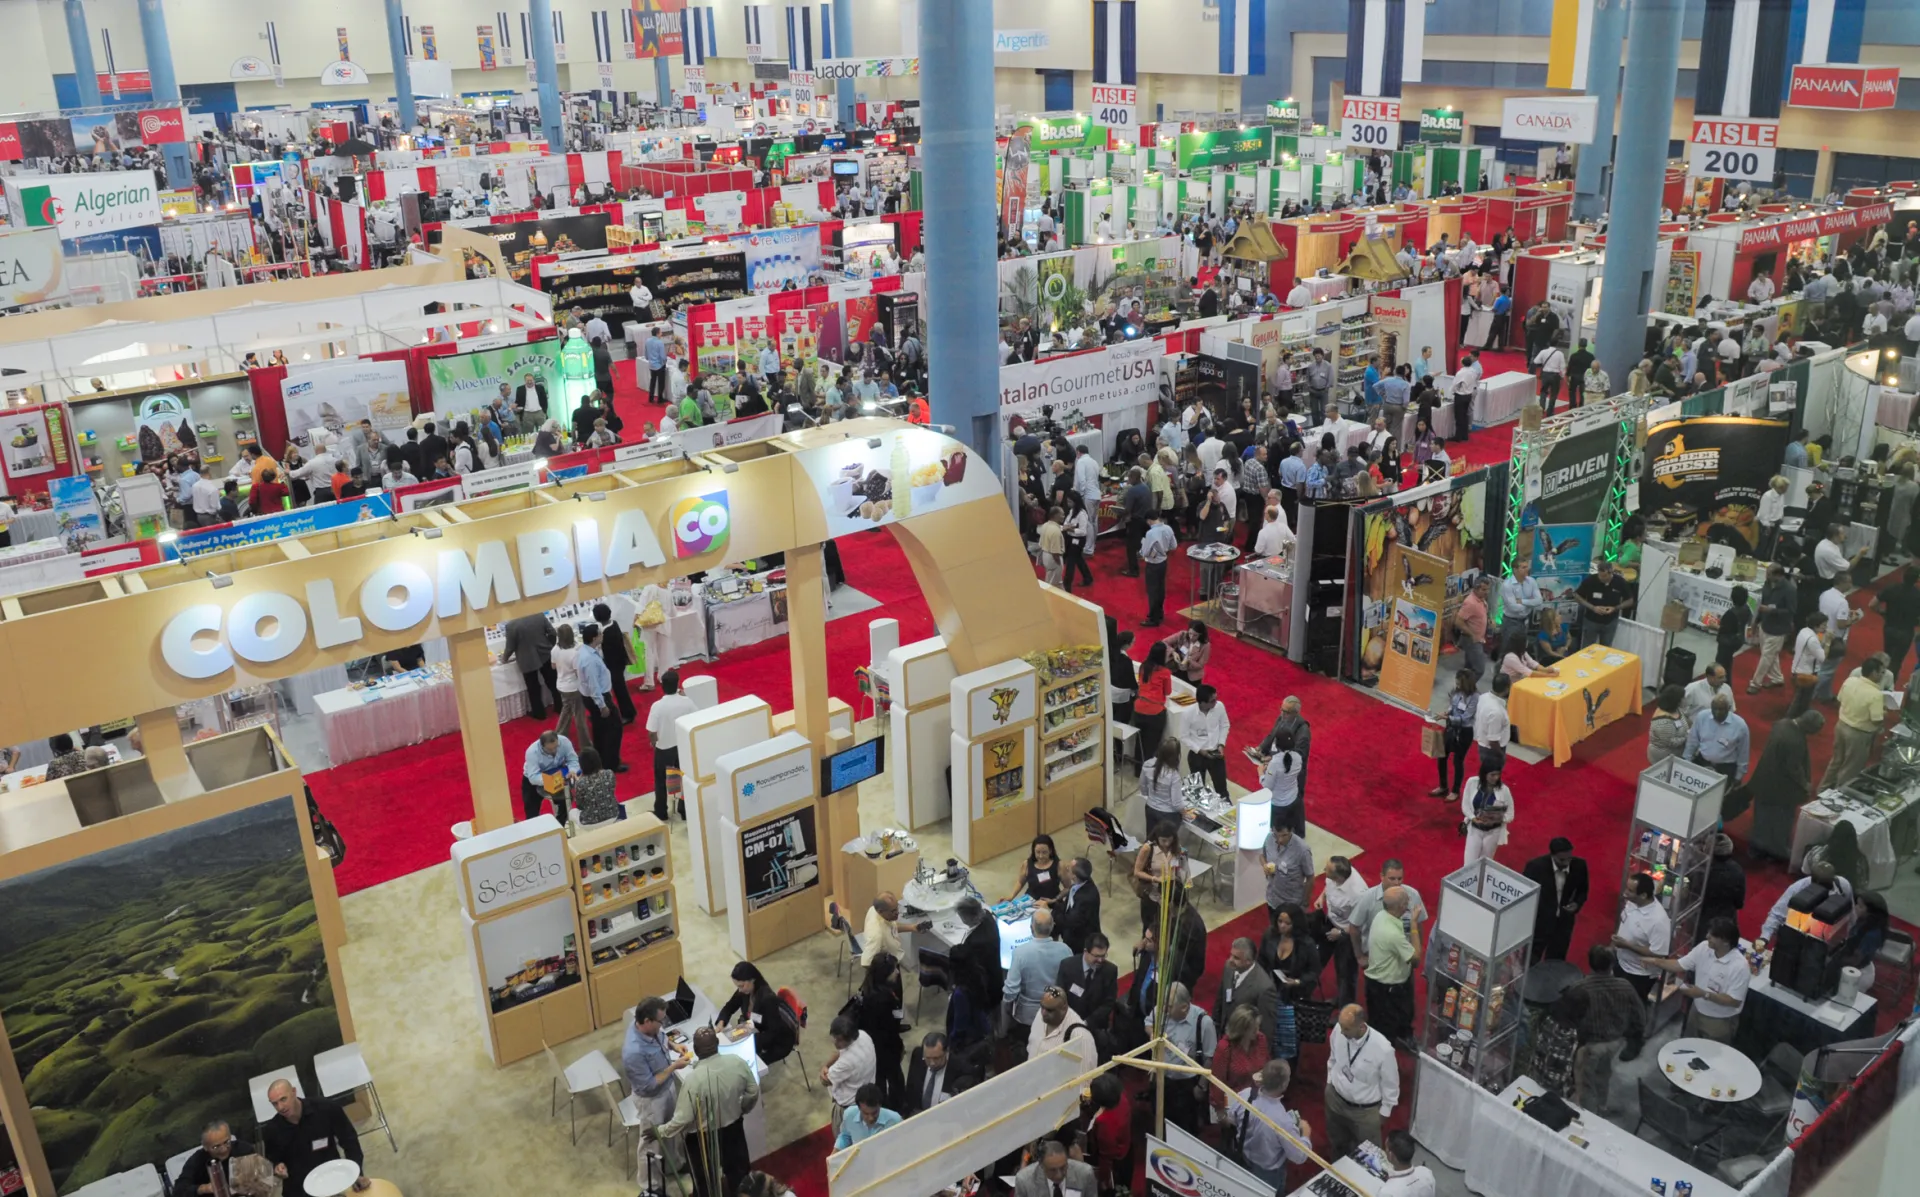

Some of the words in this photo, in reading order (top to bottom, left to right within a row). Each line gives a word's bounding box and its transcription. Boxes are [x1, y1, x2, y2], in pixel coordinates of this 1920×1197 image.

[685, 67, 704, 79] AISLE
[790, 72, 815, 87] AISLE
[689, 81, 702, 94] 700
[795, 89, 811, 102] 600
[1094, 88, 1135, 105] AISLE
[1794, 77, 1860, 98] PANAMA
[1864, 79, 1896, 95] PANAMA
[1100, 108, 1128, 125] 400
[1267, 104, 1300, 119] BRASIL
[1344, 100, 1399, 122] AISLE
[1421, 113, 1462, 130] BRASIL
[1516, 113, 1572, 129] CANADA
[1041, 123, 1085, 141] BRASIL
[1352, 123, 1388, 145] 300
[1694, 122, 1776, 147] AISLE
[1704, 150, 1759, 175] 200
[74, 185, 150, 216] Algerian
[1824, 211, 1858, 231] PANAMA
[1861, 202, 1892, 222] PANAMA
[1743, 226, 1781, 246] PANAMA
[1784, 219, 1820, 238] PANAMA
[1374, 306, 1408, 319] David's
[506, 354, 556, 377] SALUTTI
[286, 381, 314, 396] PreGel
[452, 374, 503, 393] Aloevine
[1680, 450, 1720, 461] BEER
[1557, 453, 1609, 484] RIVEN
[1653, 459, 1719, 478] CHEESE
[1556, 471, 1608, 494] DISTRIBUTORS
[677, 504, 728, 543] CO
[161, 508, 667, 679] COLOMBIA
[745, 832, 784, 859] CM-07
[478, 861, 562, 904] Selecto
